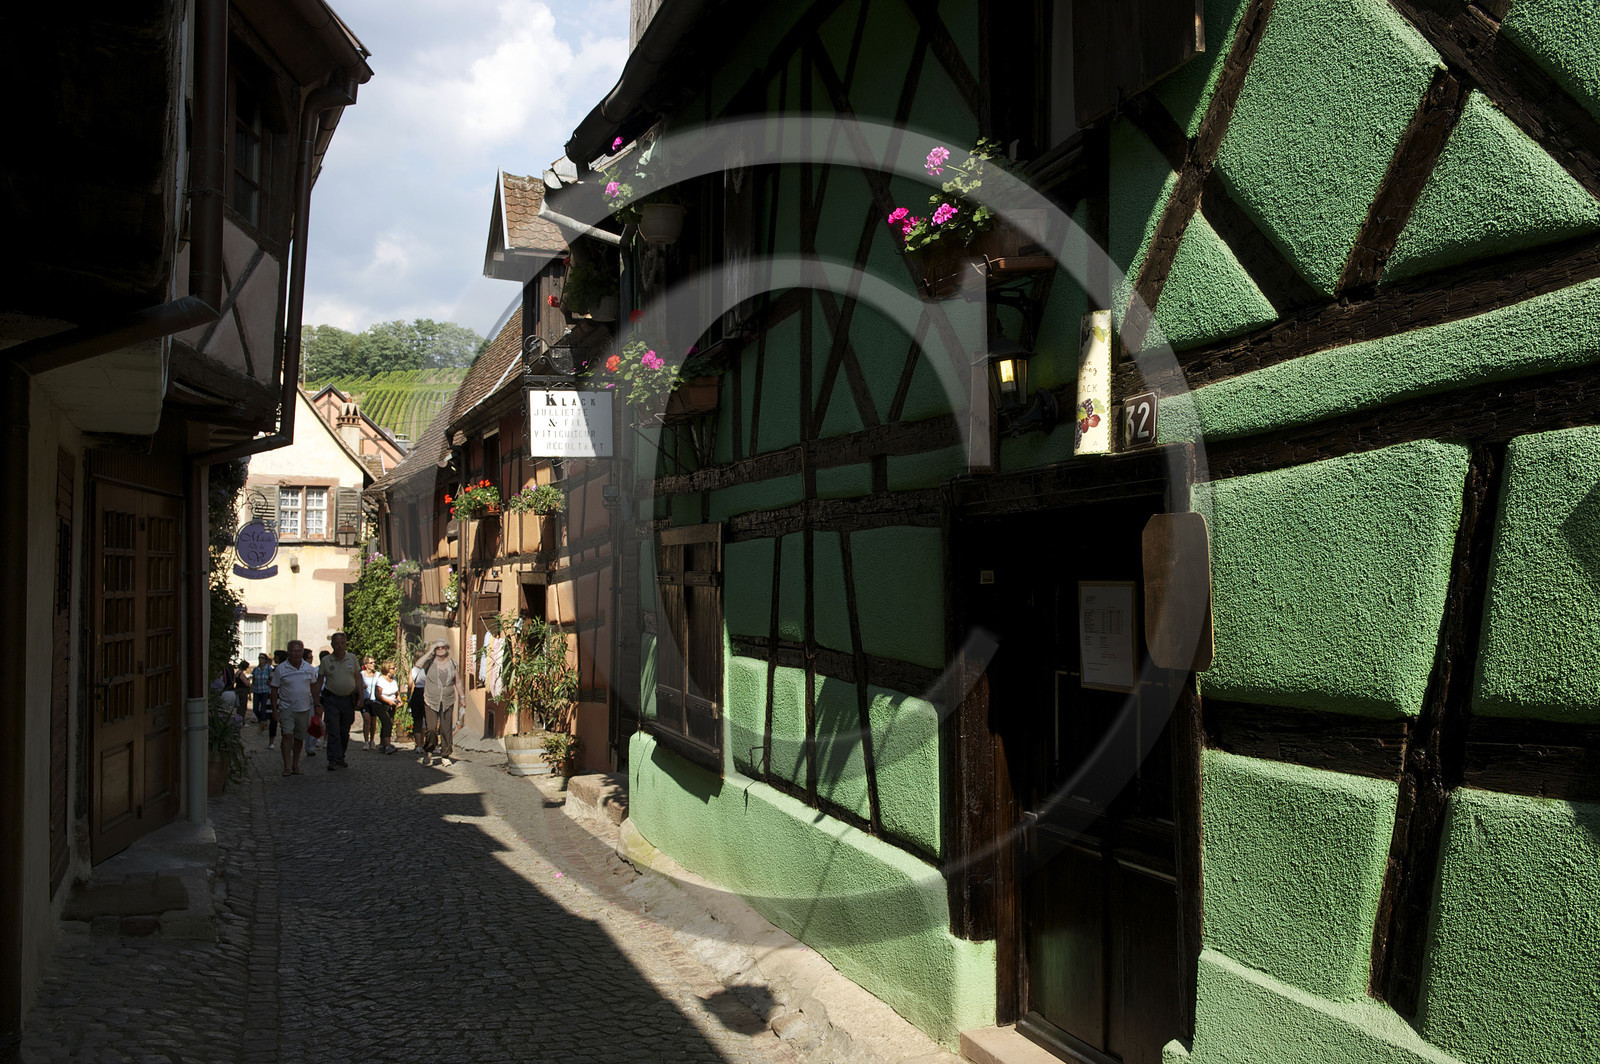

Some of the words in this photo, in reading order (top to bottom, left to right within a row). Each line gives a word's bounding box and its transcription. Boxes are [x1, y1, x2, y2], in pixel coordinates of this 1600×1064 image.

[545, 393, 596, 407] KLACK
[548, 418, 558, 428] &
[564, 418, 590, 427] FILS
[1126, 401, 1151, 440] 32
[533, 430, 596, 438] VITICULTEUR
